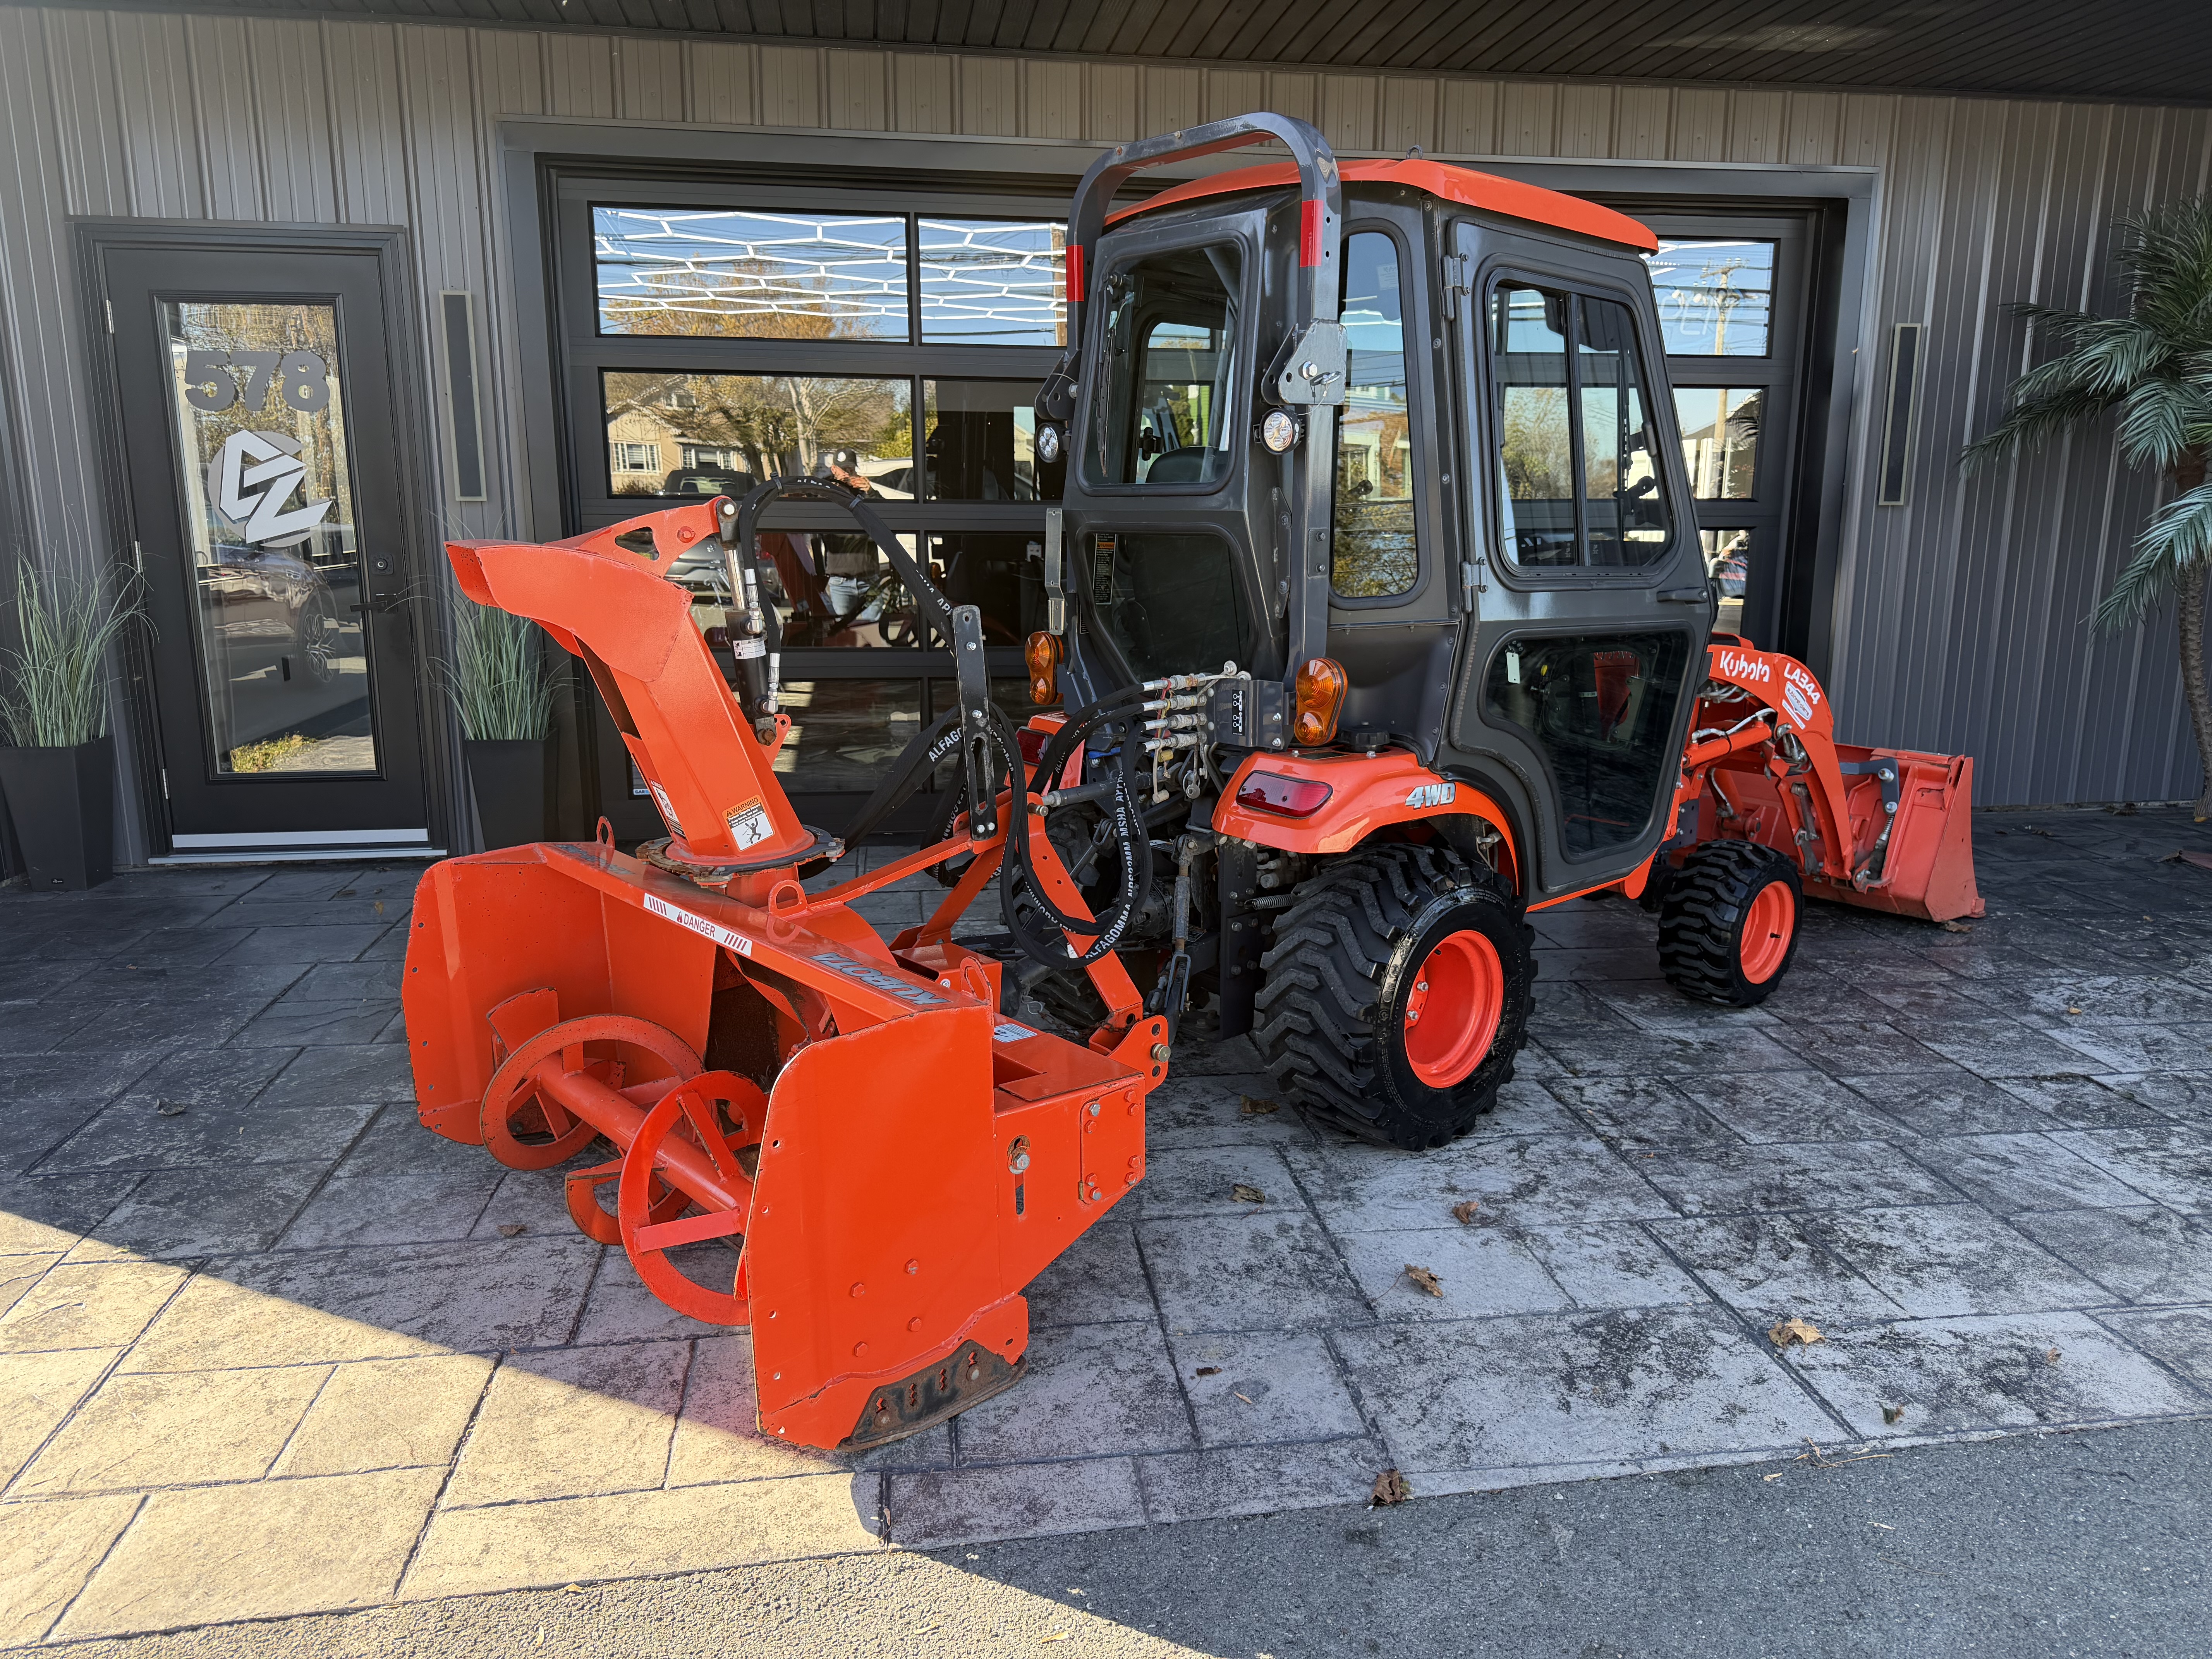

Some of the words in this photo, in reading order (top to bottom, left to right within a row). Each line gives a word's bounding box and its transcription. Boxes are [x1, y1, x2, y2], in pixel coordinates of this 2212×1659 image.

[1661, 295, 1733, 335] PEN
[185, 351, 330, 411] 578
[1720, 650, 1770, 682] Kubota
[1784, 663, 1820, 704] LA344
[731, 797, 759, 814] WARNING
[1405, 782, 1456, 810] 4WD
[1116, 807, 1129, 837] MSHA
[684, 914, 716, 938] DANGER
[809, 951, 953, 1005] KUBOTA
